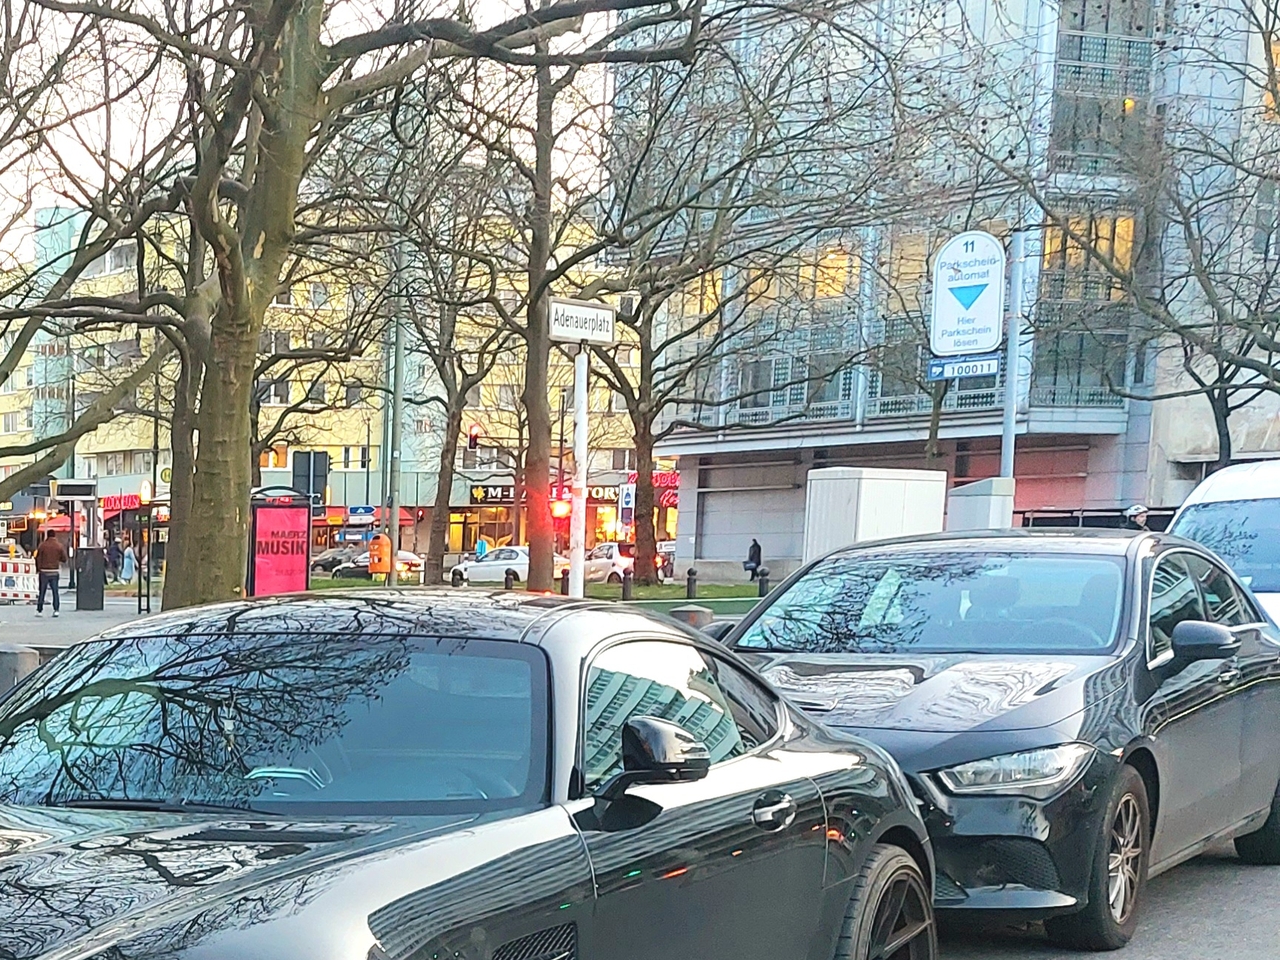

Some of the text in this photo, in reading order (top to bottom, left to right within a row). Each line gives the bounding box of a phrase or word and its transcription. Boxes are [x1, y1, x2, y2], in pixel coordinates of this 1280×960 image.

[963, 240, 975, 253] 11
[940, 255, 1000, 271] Parkschein-
[948, 269, 989, 282] automat
[553, 307, 610, 336] Adenauerplatz
[957, 317, 977, 325] Hier
[941, 326, 991, 338] Parkschein
[951, 363, 991, 375] 100011
[271, 530, 307, 539] MAERZ
[257, 540, 306, 555] MUSIK
